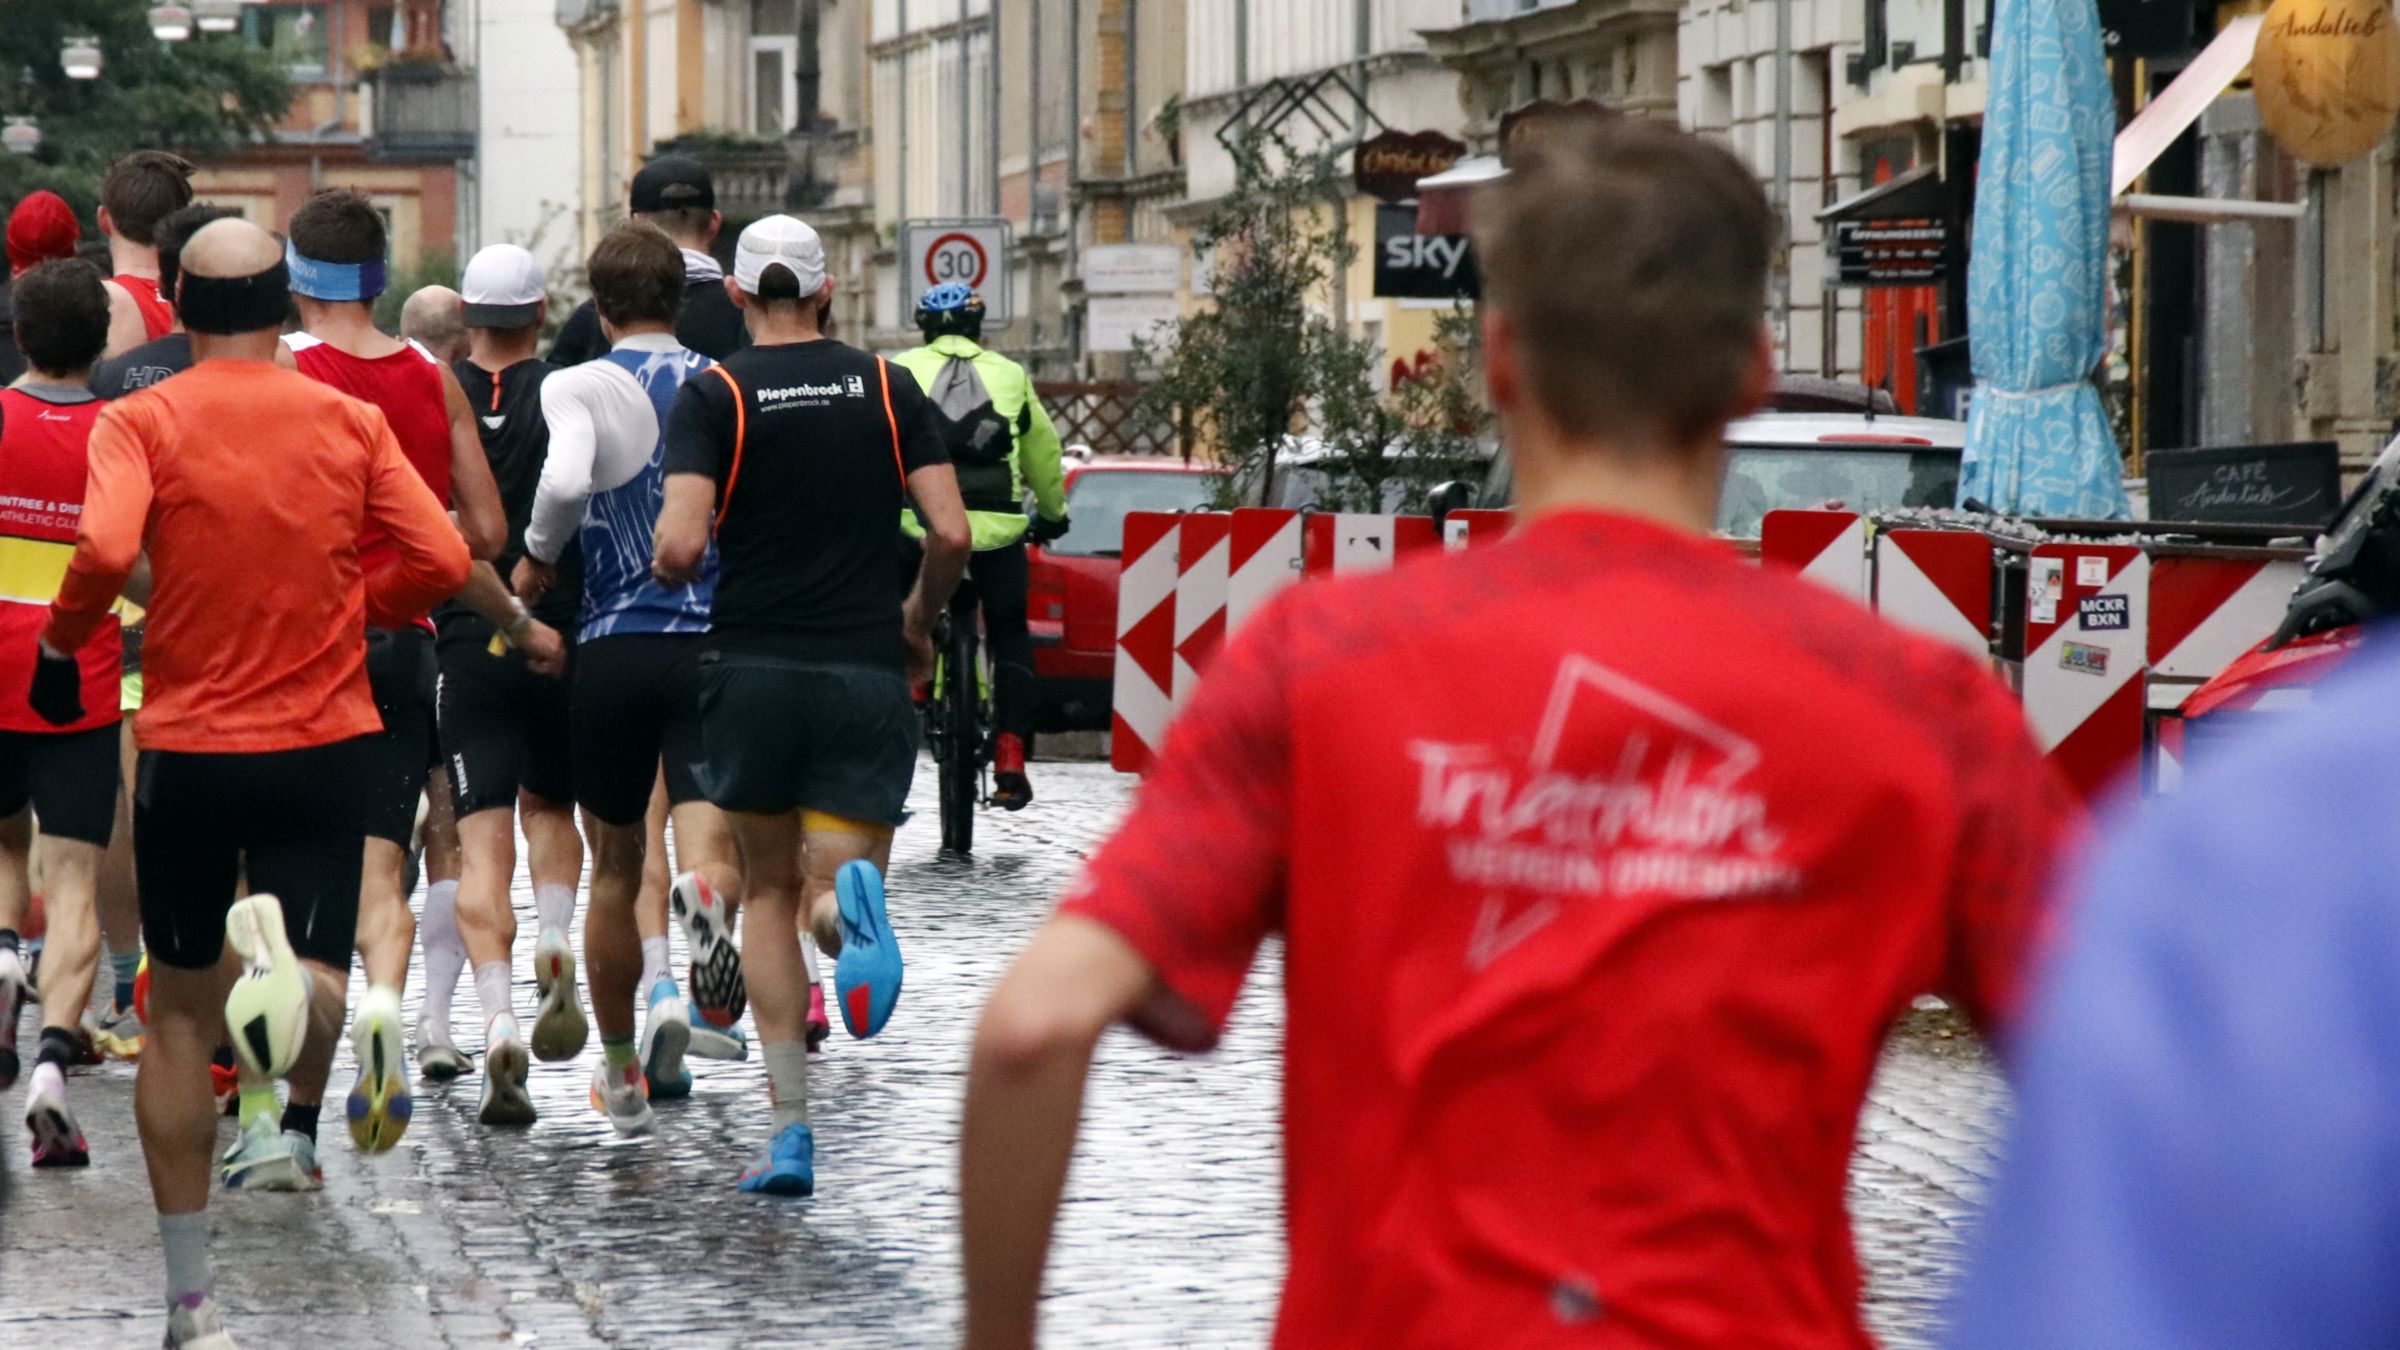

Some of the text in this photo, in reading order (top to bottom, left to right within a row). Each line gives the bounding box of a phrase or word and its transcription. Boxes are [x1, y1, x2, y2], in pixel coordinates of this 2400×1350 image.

[2272, 8, 2384, 36] Andalieb
[938, 250, 974, 279] 30
[1386, 235, 1467, 279] sky
[757, 383, 843, 402] Piepenbrock
[46, 501, 56, 512] &
[0, 510, 54, 528] ATHLETIC
[2081, 598, 2126, 613] MCKR
[2087, 613, 2121, 627] BXN
